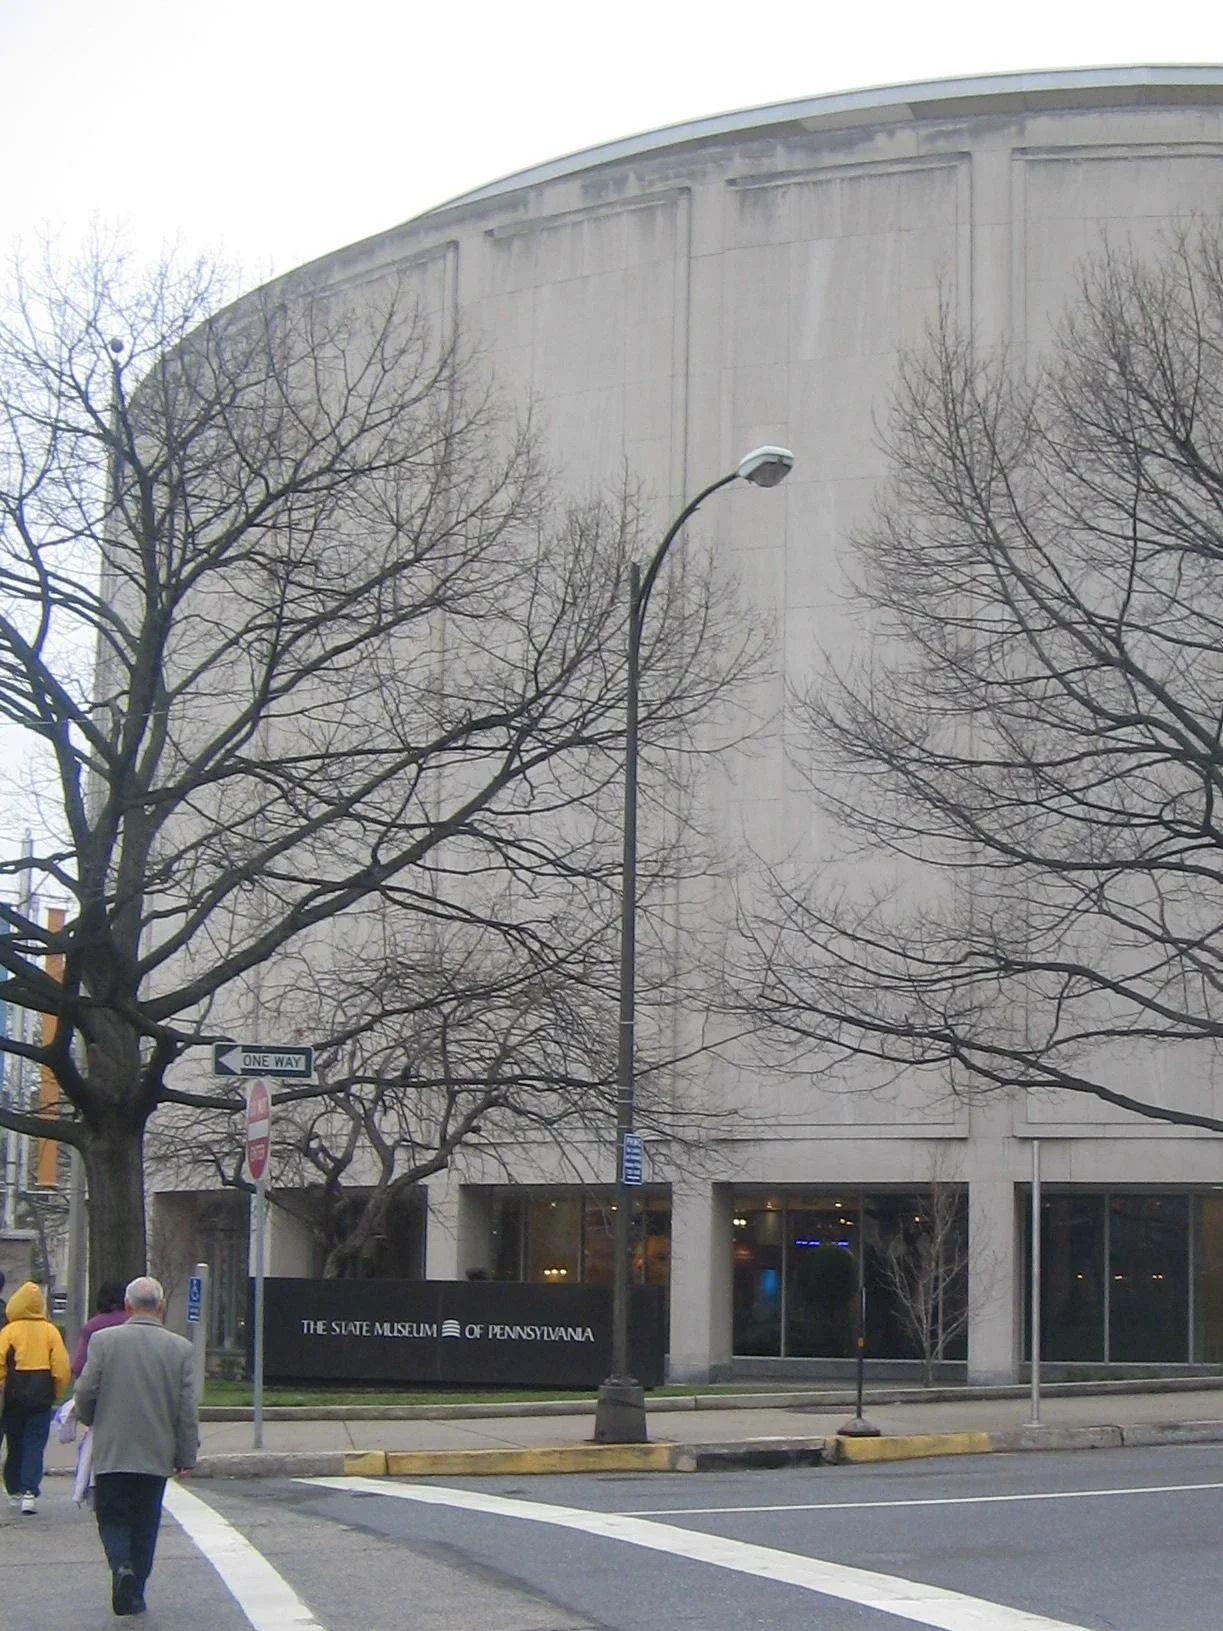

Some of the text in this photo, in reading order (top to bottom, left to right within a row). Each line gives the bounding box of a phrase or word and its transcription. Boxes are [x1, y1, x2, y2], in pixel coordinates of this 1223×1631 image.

[243, 1054, 301, 1068] ONE WAY
[301, 1320, 594, 1342] THE STATE MUSEUM OF PENNSYLVANIA
